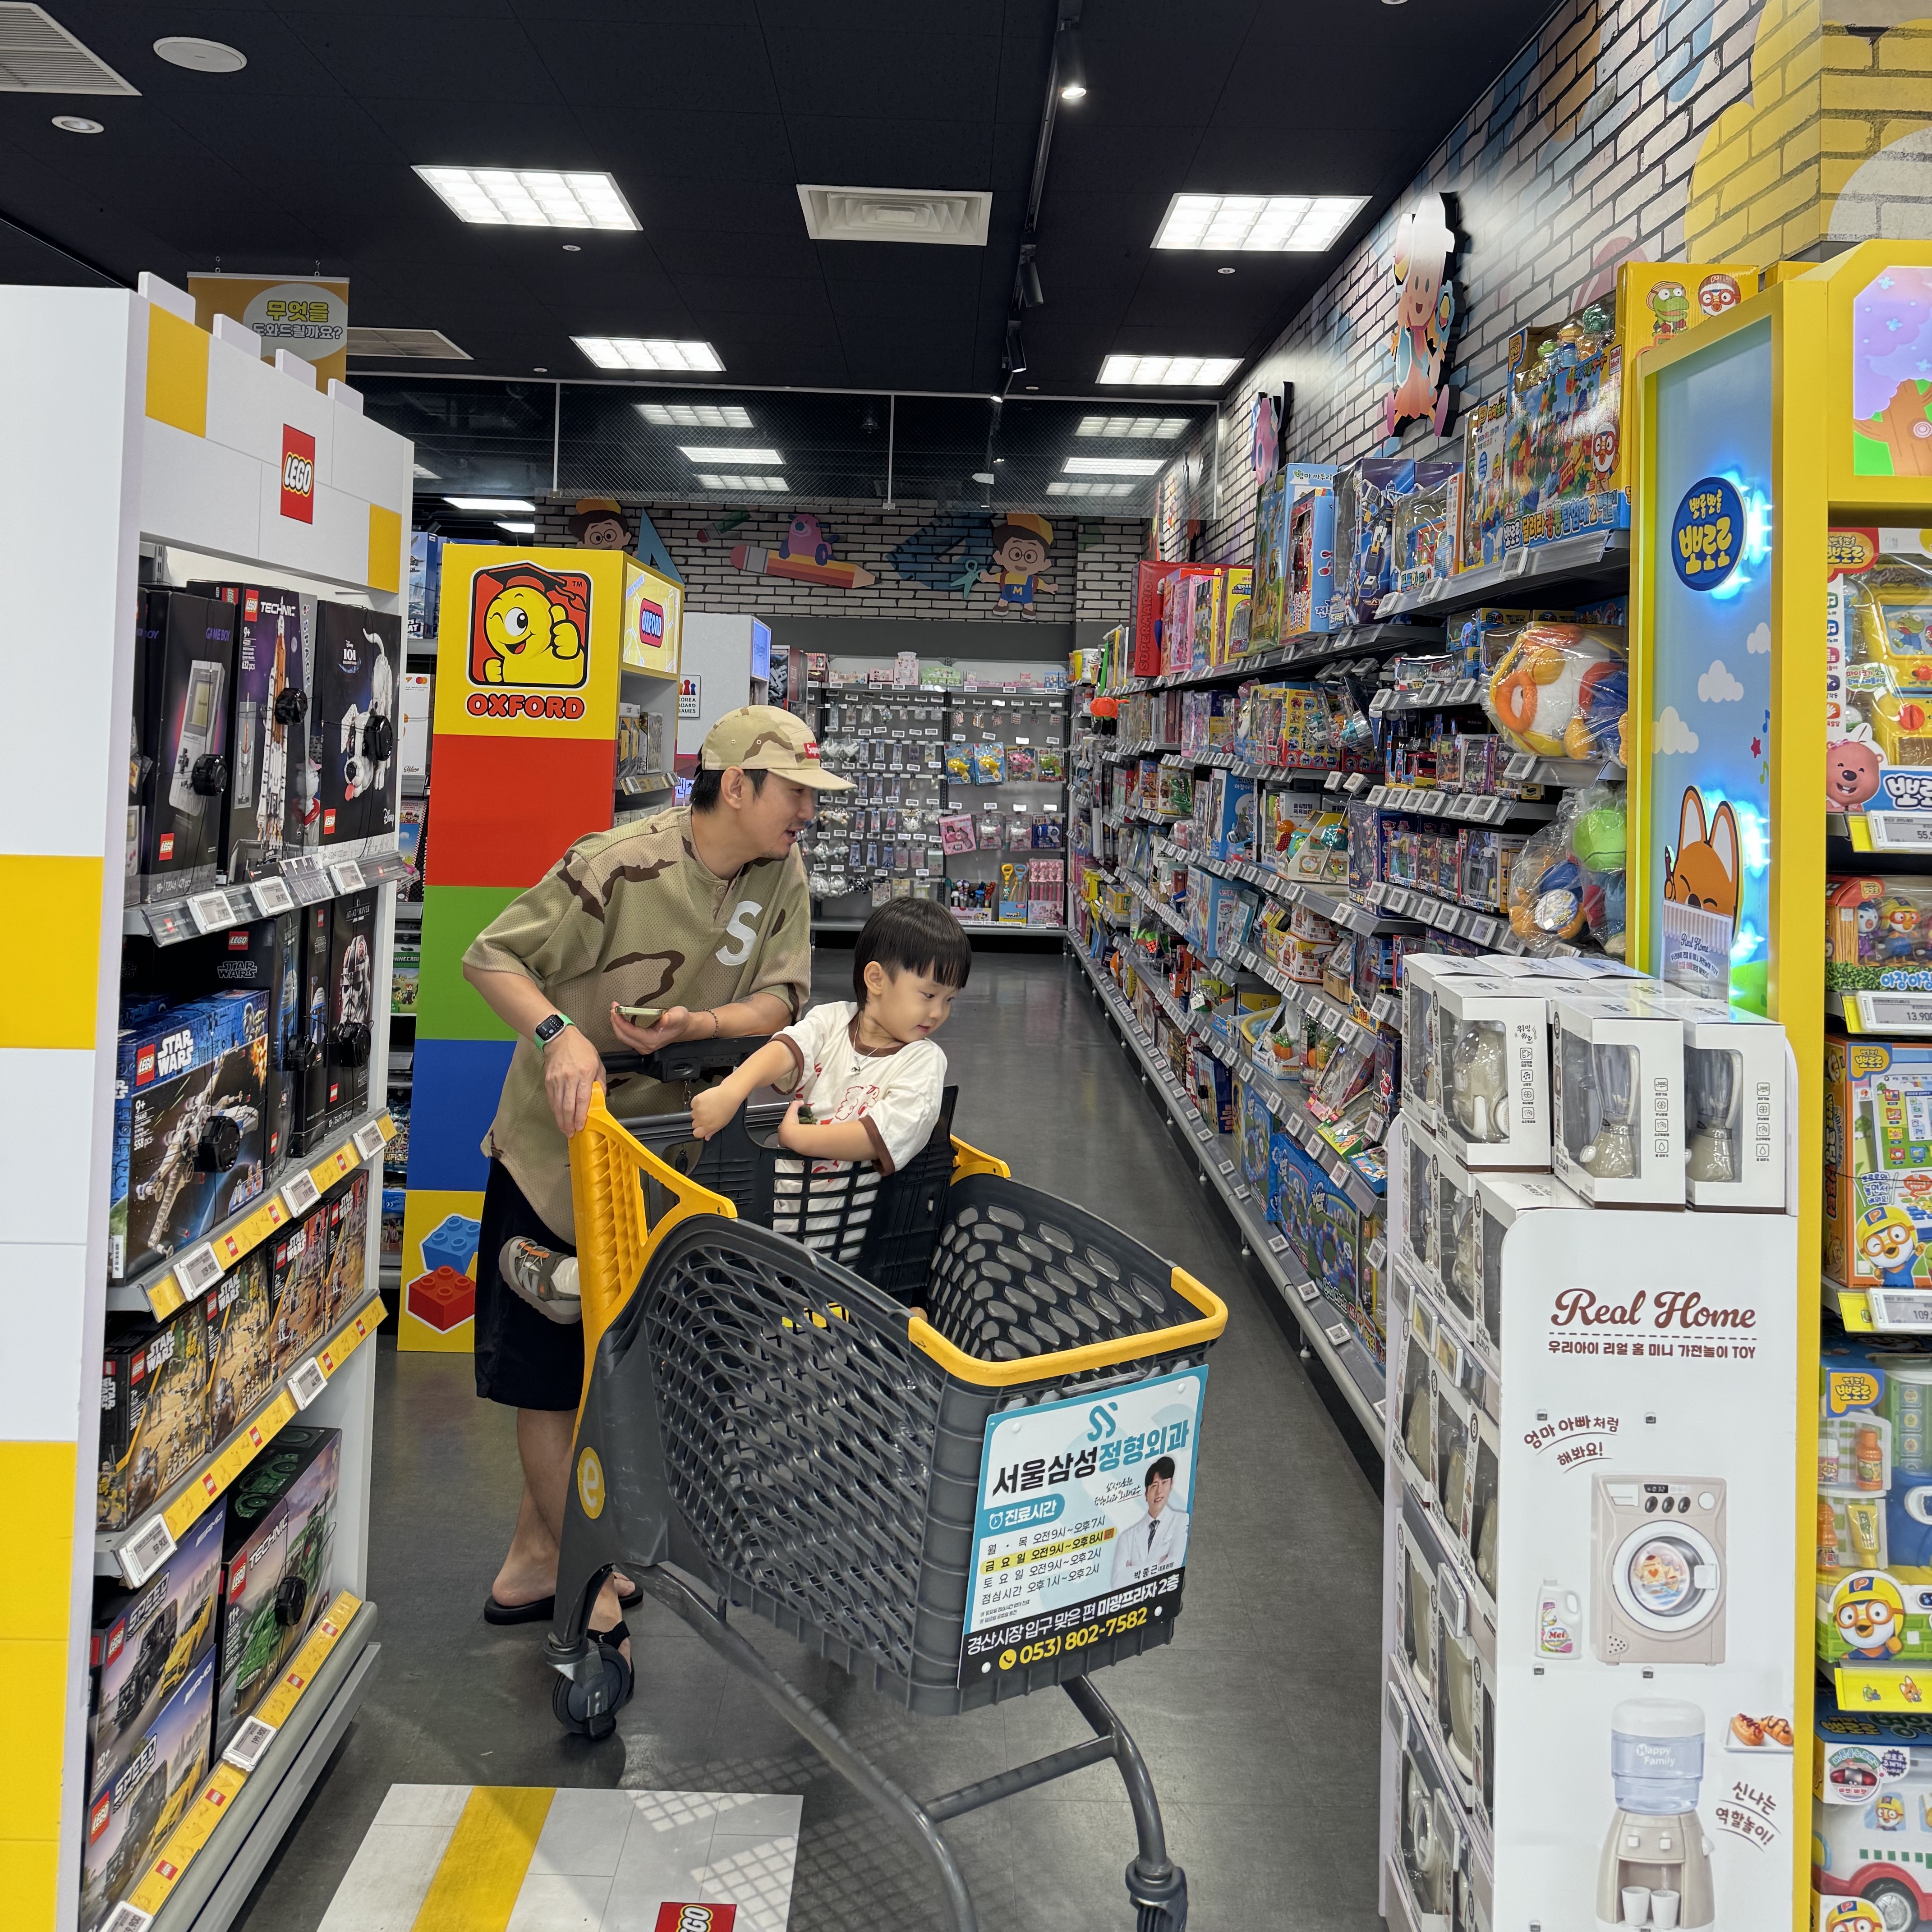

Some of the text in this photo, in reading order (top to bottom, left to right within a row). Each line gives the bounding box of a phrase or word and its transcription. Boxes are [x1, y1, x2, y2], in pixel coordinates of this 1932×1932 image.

[267, 300, 329, 322] 무엇을
[253, 323, 343, 339] 도와드릴까요?
[283, 452, 313, 496] LEGO
[1689, 488, 1722, 519] 뽀롱뽀롱
[1504, 521, 1520, 547] 뽀로로
[1522, 511, 1546, 545] 달려라
[1678, 517, 1732, 575] 뽀로로
[1827, 545, 1864, 564] 뽀로로
[246, 598, 296, 617] LEGO TECHNIC
[642, 610, 662, 638] OXFORD
[344, 648, 356, 661] 101
[467, 694, 585, 720] OXFORD
[324, 815, 336, 827] LEGO
[160, 840, 174, 853] LEGO
[229, 936, 248, 945] LEGO
[716, 900, 764, 966] S
[1680, 933, 1709, 953] Real Home
[217, 961, 257, 970] STAR
[217, 969, 257, 978] WARS
[157, 1029, 194, 1060] STAR
[138, 1046, 194, 1077] LEGO WARS
[1854, 1055, 1883, 1068] 뽀로로
[135, 1100, 146, 1113] 9+
[134, 1136, 154, 1151] 558 pcs
[339, 1190, 354, 1209] STAR
[339, 1201, 354, 1220] WARS
[287, 1228, 307, 1250] STAR
[287, 1240, 307, 1262] WARS
[218, 1273, 240, 1296] STAR
[218, 1285, 240, 1312] WARS
[1550, 1287, 1757, 1329] Real Home
[146, 1330, 175, 1359] STAR
[1548, 1340, 1756, 1359] 우리아이 리얼 홈 미니 가전놀이 TOY
[132, 1344, 175, 1380] LEGO WARS
[1835, 1384, 1871, 1401] 뽀로로
[1523, 1424, 1556, 1450] 엄마
[1556, 1442, 1603, 1467] 해봐요!
[1005, 1500, 1057, 1527] 진료시간
[249, 1512, 290, 1571] TECHNIC
[988, 1543, 997, 1556] 월
[1019, 1536, 1027, 1547] 목
[231, 1562, 246, 1593] LEGO
[129, 1570, 170, 1629] SPEED
[982, 1585, 1022, 1606] 점심시간
[228, 1606, 239, 1626] 11+
[967, 1625, 1024, 1656] 경산시장
[1025, 1616, 1053, 1639] 입구
[1097, 1585, 1157, 1617] 미광프라자
[1158, 1573, 1180, 1595] 2층
[107, 1626, 125, 1658] LEGO
[1019, 1606, 1148, 1665] 053) 802-7582
[97, 1748, 110, 1771] 10+
[1636, 1743, 1672, 1757] Happy
[1644, 1756, 1676, 1767] Family
[114, 1734, 158, 1805] SPEED
[1731, 1781, 1777, 1816] 신나는
[92, 1800, 110, 1835] LEGO
[1715, 1806, 1775, 1846] 역할놀이!
